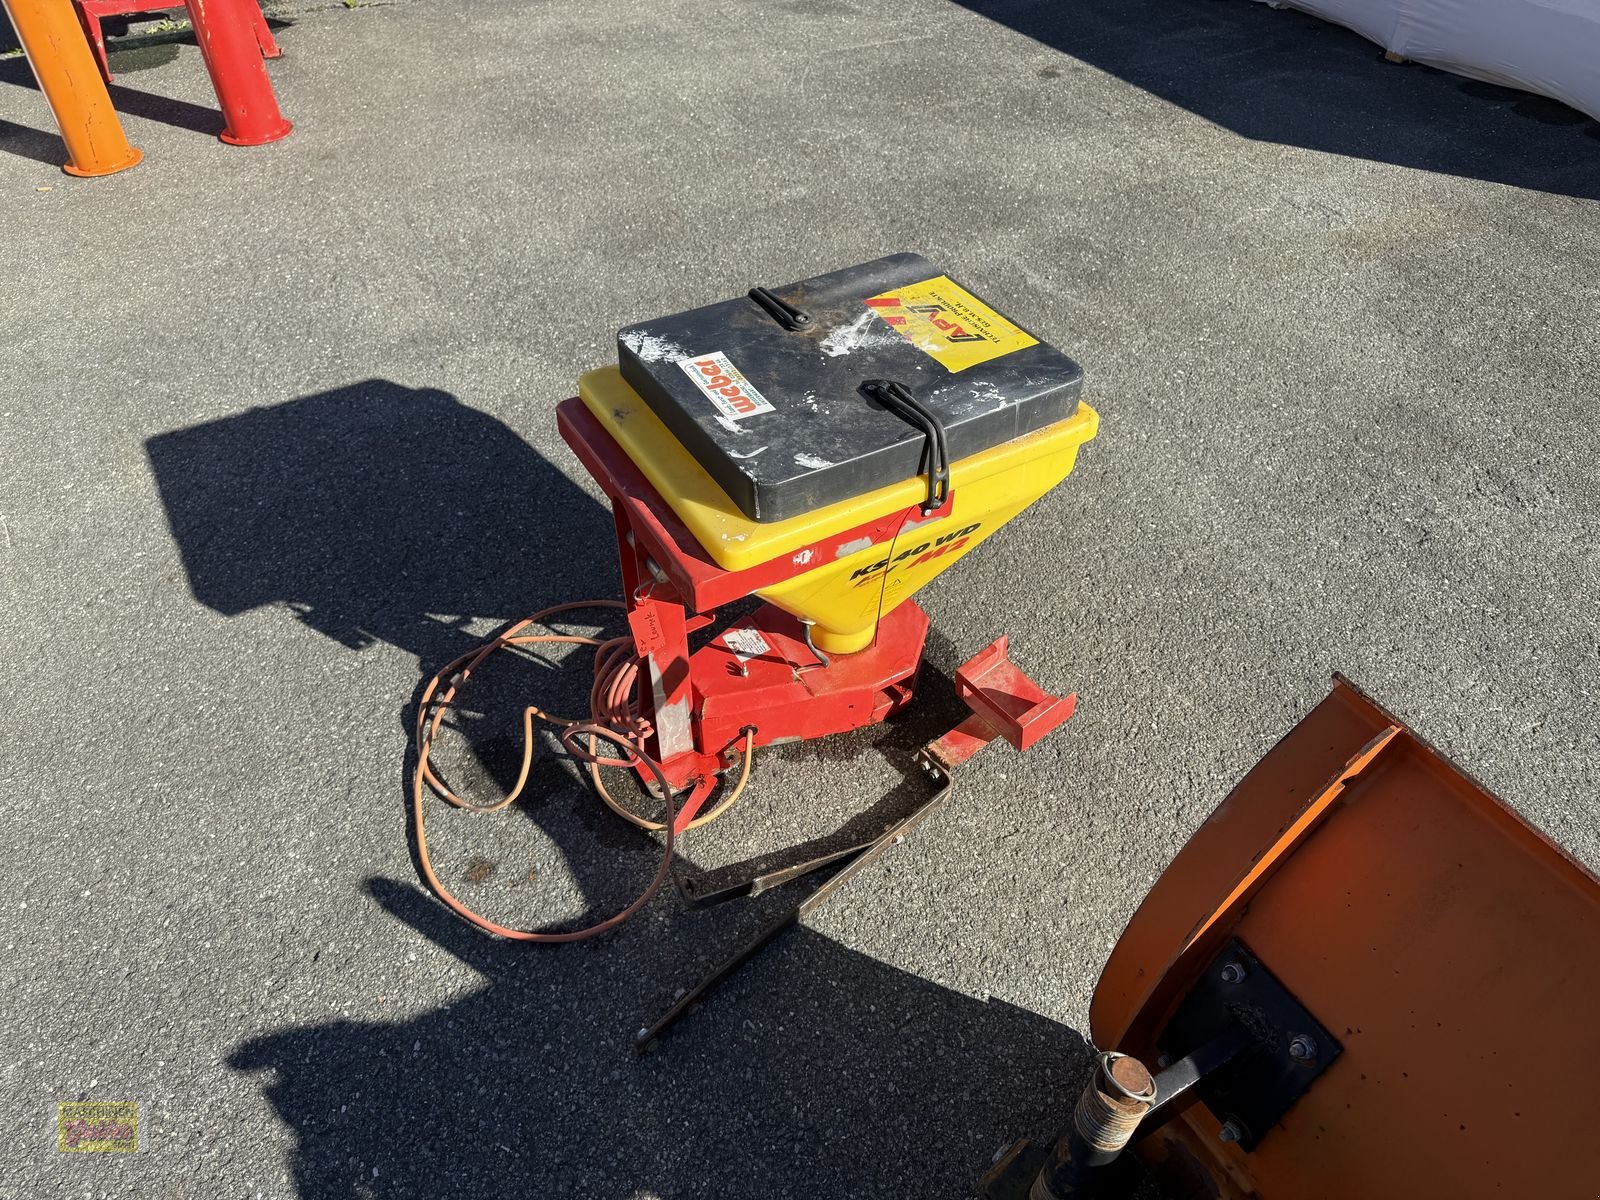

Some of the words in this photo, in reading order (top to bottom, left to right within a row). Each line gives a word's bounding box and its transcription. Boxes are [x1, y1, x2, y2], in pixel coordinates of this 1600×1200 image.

[693, 359, 757, 414] weber
[935, 522, 982, 547] WD
[905, 536, 970, 570] M2
